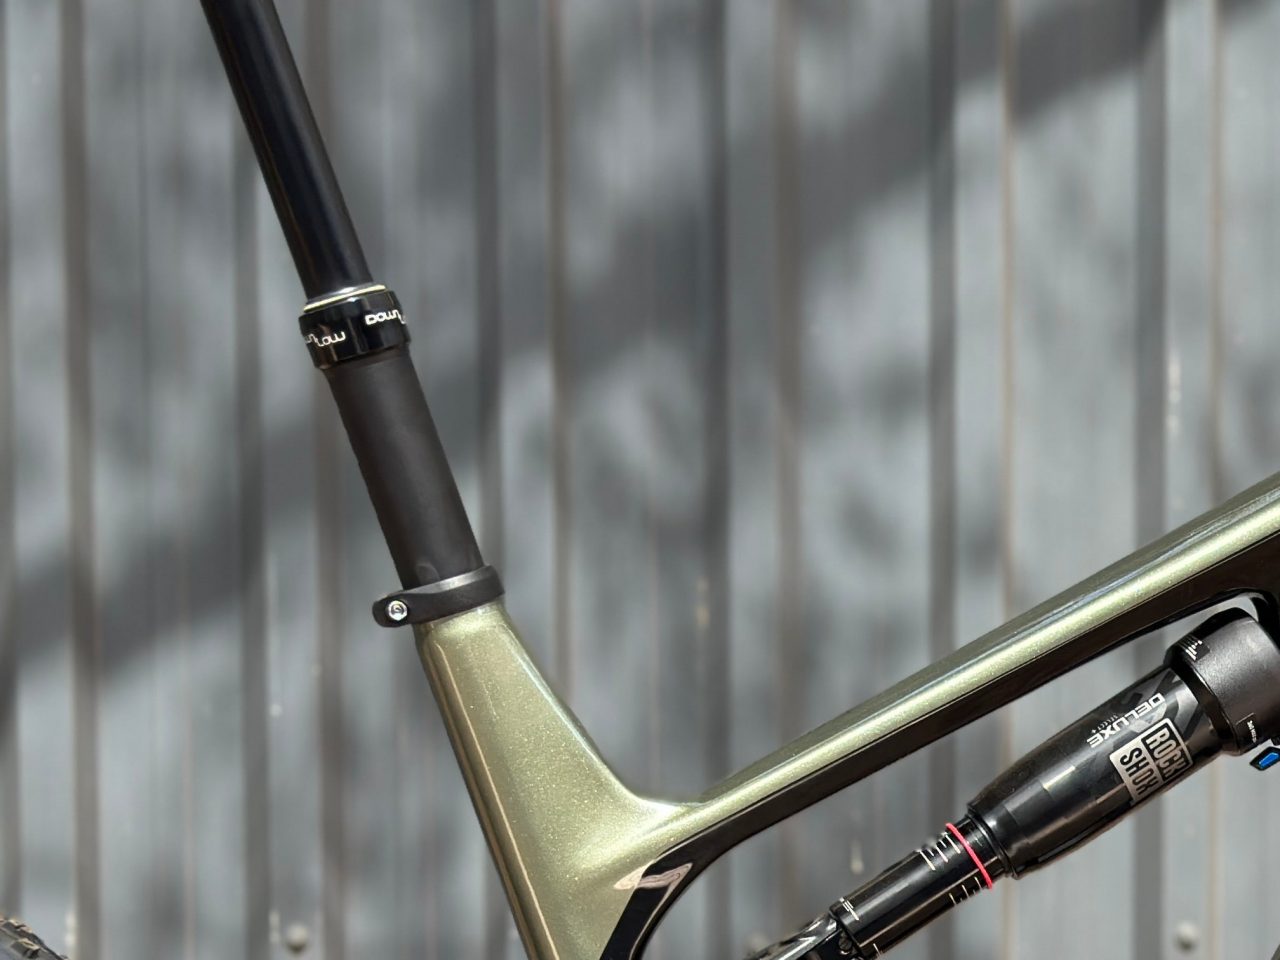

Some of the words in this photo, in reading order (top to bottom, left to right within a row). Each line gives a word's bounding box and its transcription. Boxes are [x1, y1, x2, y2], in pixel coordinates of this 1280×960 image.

[1086, 692, 1167, 748] DELUXE
[1119, 747, 1159, 796] SHOX
[1145, 726, 1188, 778] ROCK
